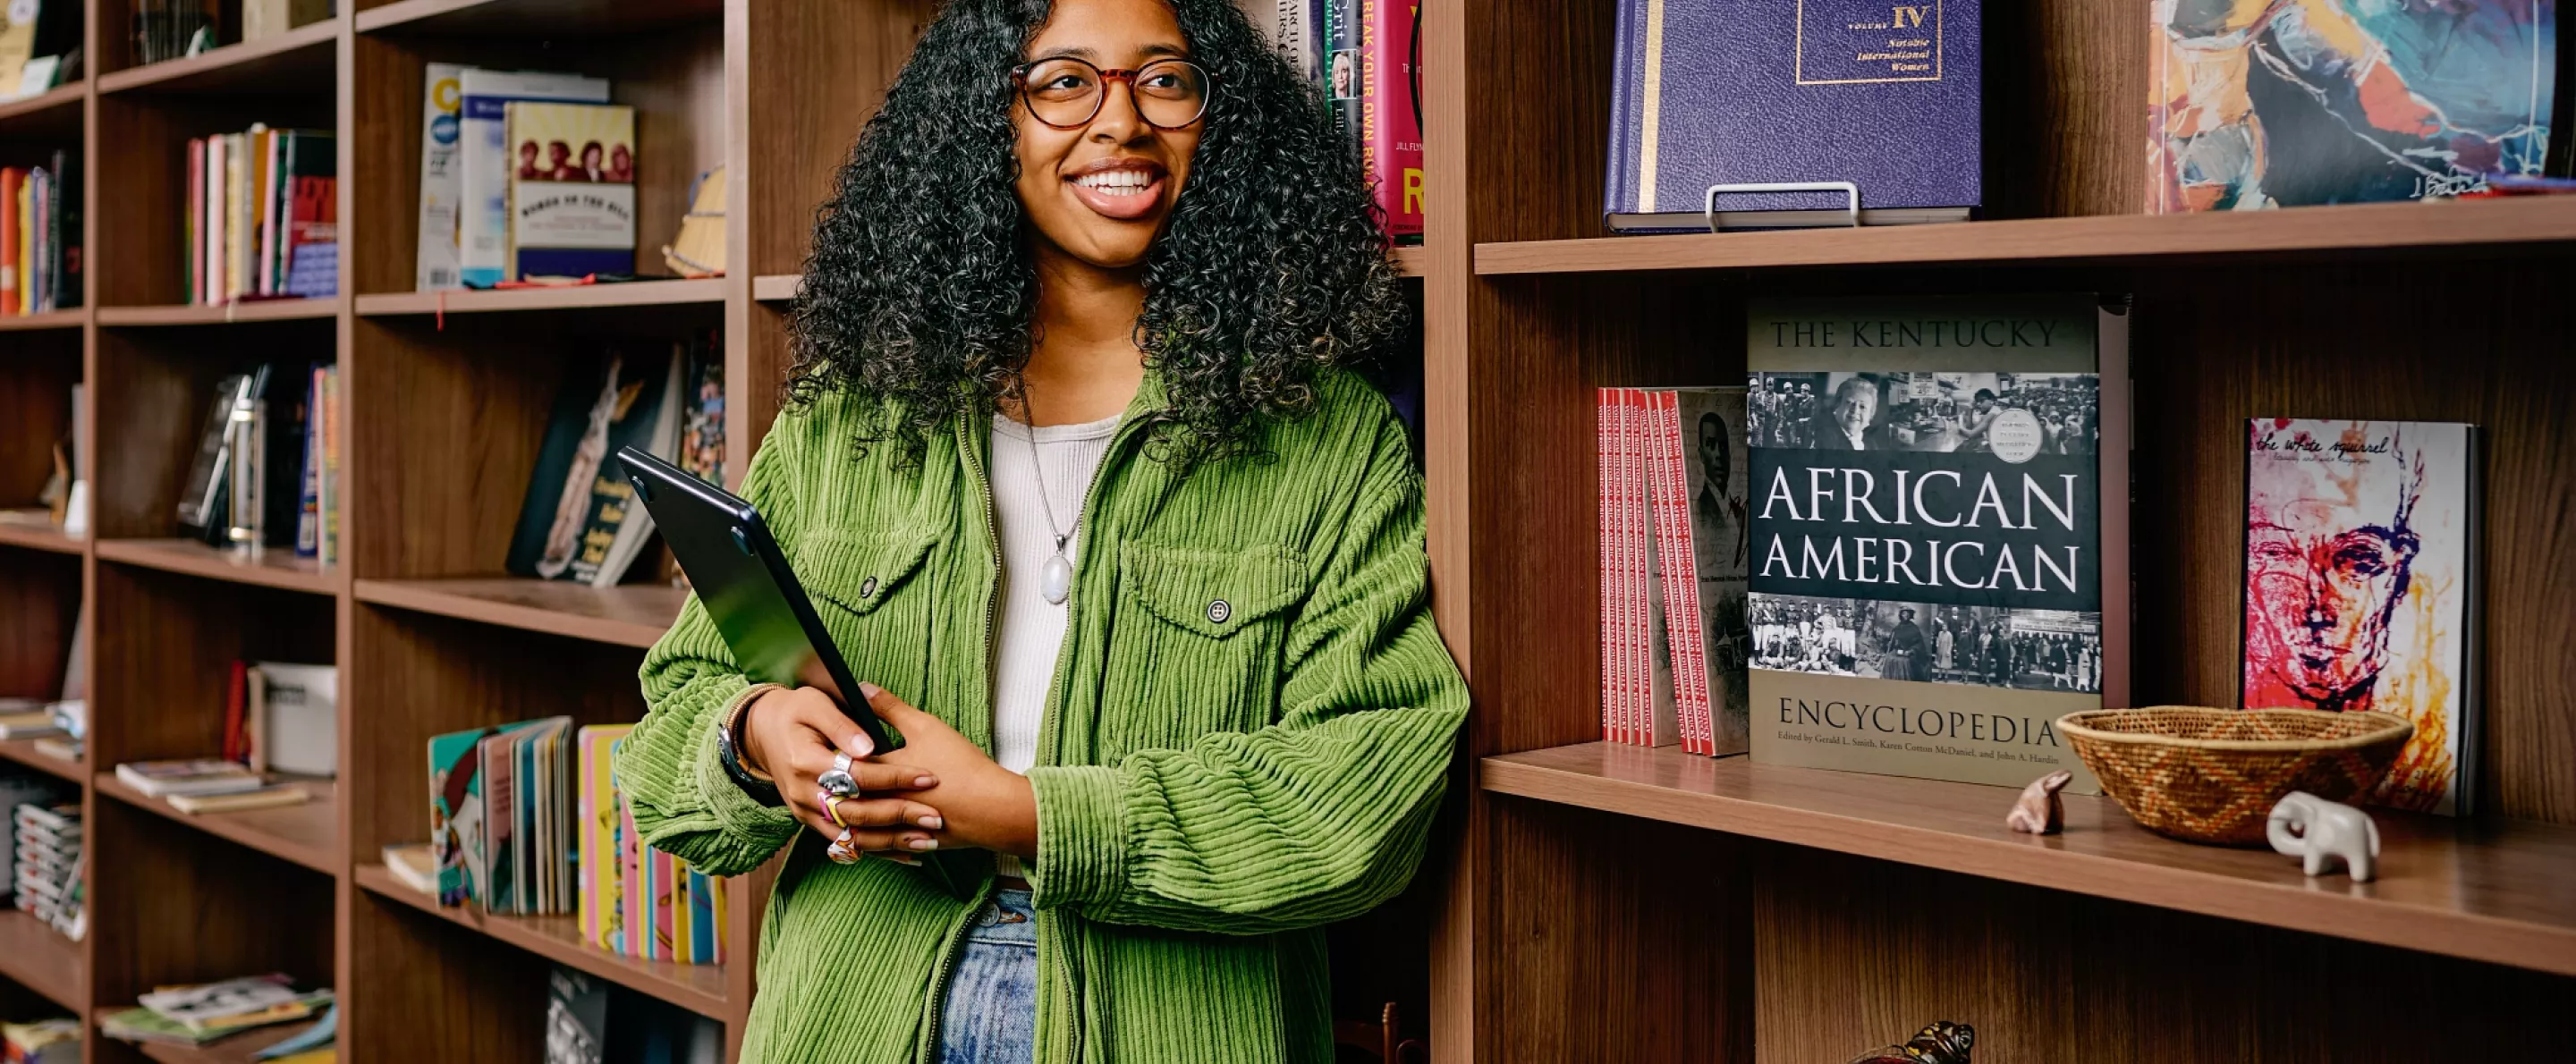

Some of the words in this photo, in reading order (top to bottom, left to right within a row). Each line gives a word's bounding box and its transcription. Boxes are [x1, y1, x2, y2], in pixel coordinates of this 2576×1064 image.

[1334, 0, 1350, 41] Grit
[1363, 2, 1374, 46] REAK
[1892, 6, 1931, 29] IV
[1857, 50, 1929, 61] International
[1888, 38, 1929, 47] Notable
[1363, 50, 1374, 97] YOUR
[1363, 102, 1374, 140] OWN
[1770, 321, 1835, 348] THE
[1852, 319, 2058, 348] KENTUCKY
[1670, 407, 1678, 433] VOICES
[2256, 433, 2279, 451] the
[2285, 434, 2322, 452] white
[2329, 436, 2389, 459] squirrel
[1675, 458, 1685, 501] HISTORICAL
[1758, 466, 2078, 531] AFRICAN
[1681, 503, 1689, 535] AFRICAN
[1684, 537, 1693, 575] AMERICAN
[1759, 533, 2080, 594] AMERICAN
[1648, 459, 1657, 502] HISTORICAL
[1653, 504, 1661, 535] AFRICAN
[1657, 536, 1665, 575] AMERICAN
[1661, 576, 1673, 629] COMMUNITIES
[1676, 698, 1685, 739] KENTUCKY
[1689, 577, 1699, 629] COMMUNITIES
[1663, 504, 1671, 535] AFRICAN
[1667, 537, 1676, 575] AMERICAN
[1686, 699, 1696, 739] KENTUCKY
[1702, 701, 1710, 740] KENTUCKY
[1778, 697, 2059, 747] ENCYCLOPEDIA
[1778, 730, 1801, 740] Edited
[1804, 733, 1813, 743] by
[1815, 734, 1840, 744] Gerald
[1843, 737, 1850, 745] L.
[1852, 738, 1877, 748] Smith,
[1880, 740, 1902, 749] Karen
[1905, 743, 1932, 753] Cotton
[1936, 746, 1977, 757] McDaniel,
[1979, 750, 1994, 759] and
[1996, 751, 2015, 761] John
[2030, 755, 2059, 764] Hardin
